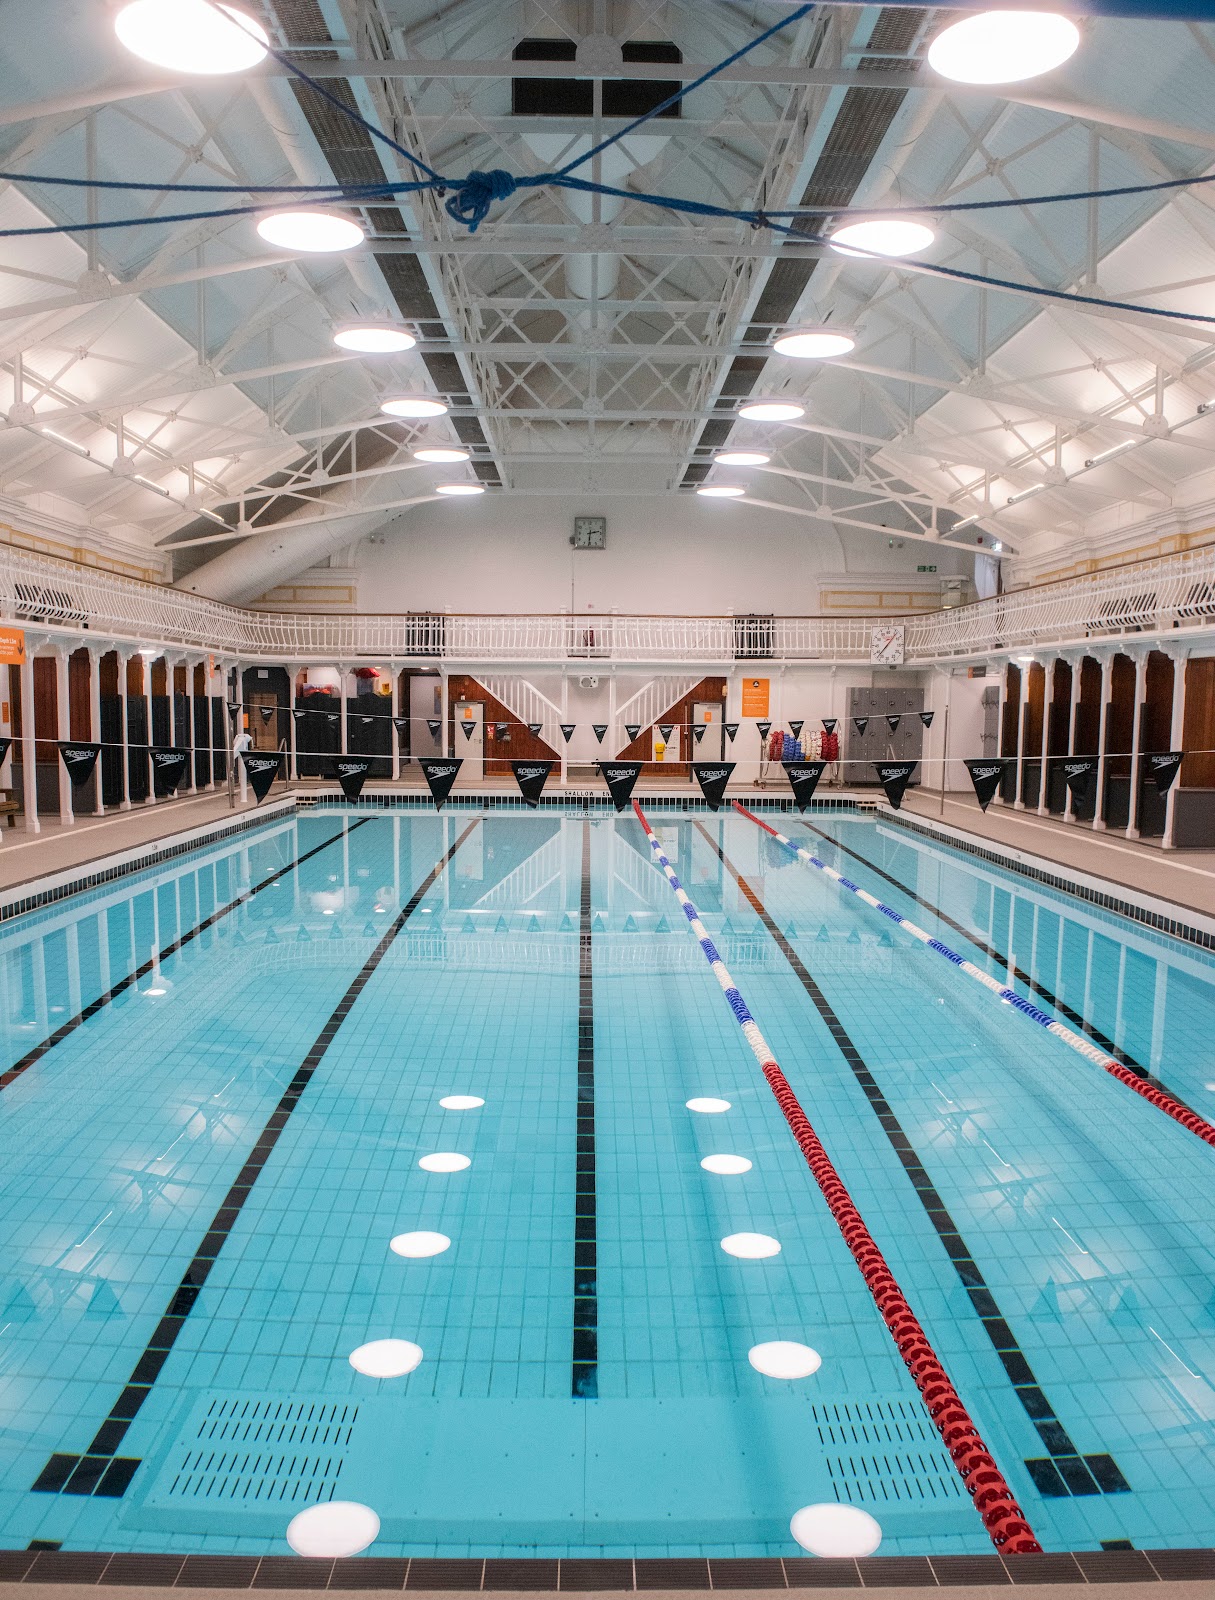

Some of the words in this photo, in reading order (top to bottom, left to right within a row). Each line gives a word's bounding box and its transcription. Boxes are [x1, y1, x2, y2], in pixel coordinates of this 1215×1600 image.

[65, 750, 95, 758] speedo
[1152, 755, 1180, 763] speedo
[338, 763, 368, 771] speedo
[517, 767, 547, 775] speedo
[881, 767, 910, 775] speedo
[973, 766, 1001, 774] speedo
[1065, 762, 1092, 772] speedo
[607, 768, 636, 776] speedo
[700, 769, 728, 777] speedo
[791, 768, 819, 776] speedo
